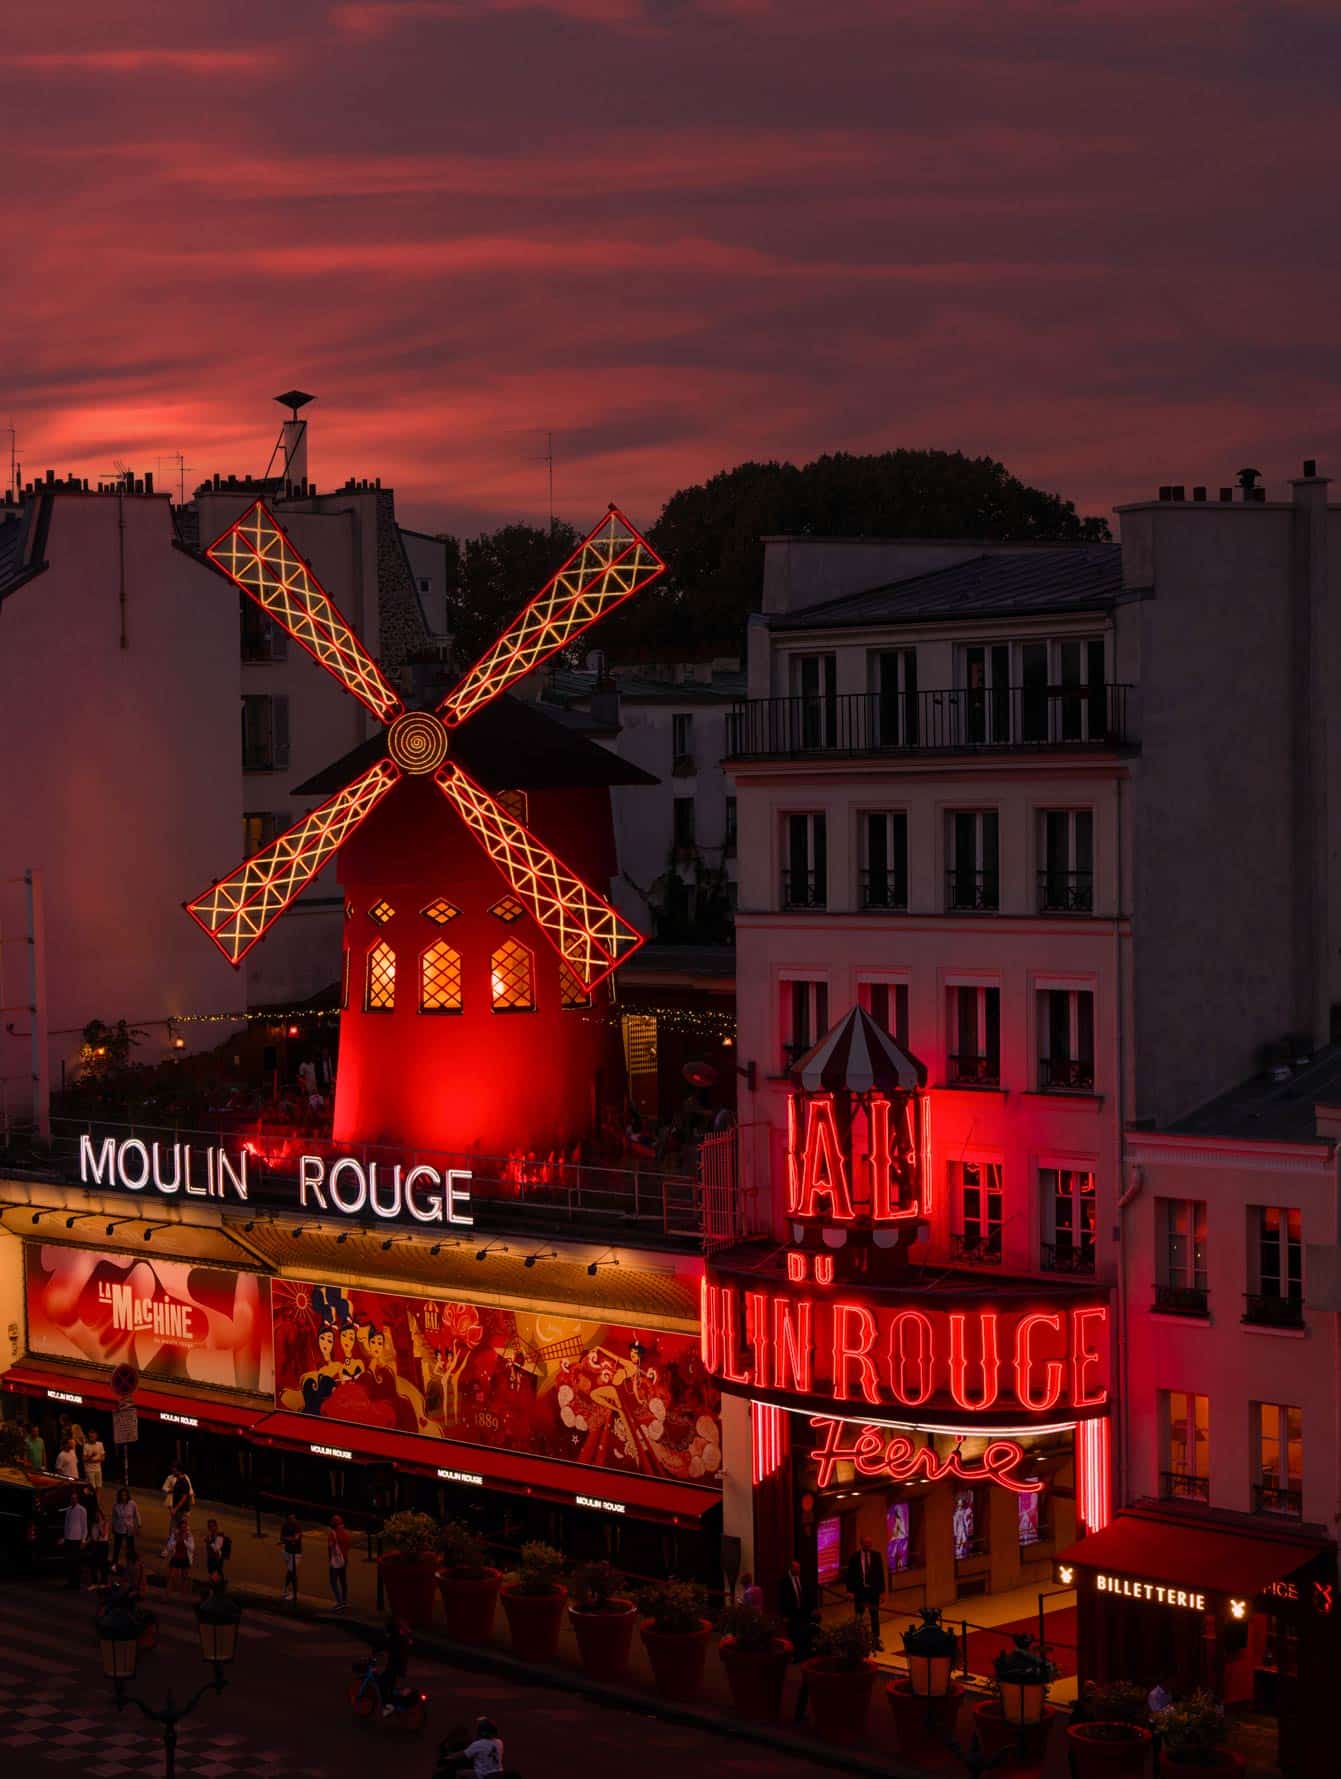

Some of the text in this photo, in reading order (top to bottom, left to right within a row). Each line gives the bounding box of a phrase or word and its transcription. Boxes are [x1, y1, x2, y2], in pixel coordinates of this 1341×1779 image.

[786, 1093, 933, 1220] AL
[80, 1134, 474, 1226] MOULIN ROUGE
[787, 1252, 834, 1285] DU
[98, 1281, 111, 1298] LA
[831, 1304, 1108, 1412] ROUGE
[475, 1412, 498, 1432] 1889
[810, 1416, 1046, 1494] Féerie
[437, 1469, 483, 1485] MOULIN ROUGE
[576, 1496, 625, 1513] MOULIN ROUGE
[1096, 1574, 1206, 1611] BILLETTERIE
[1263, 1581, 1299, 1600] ICE
